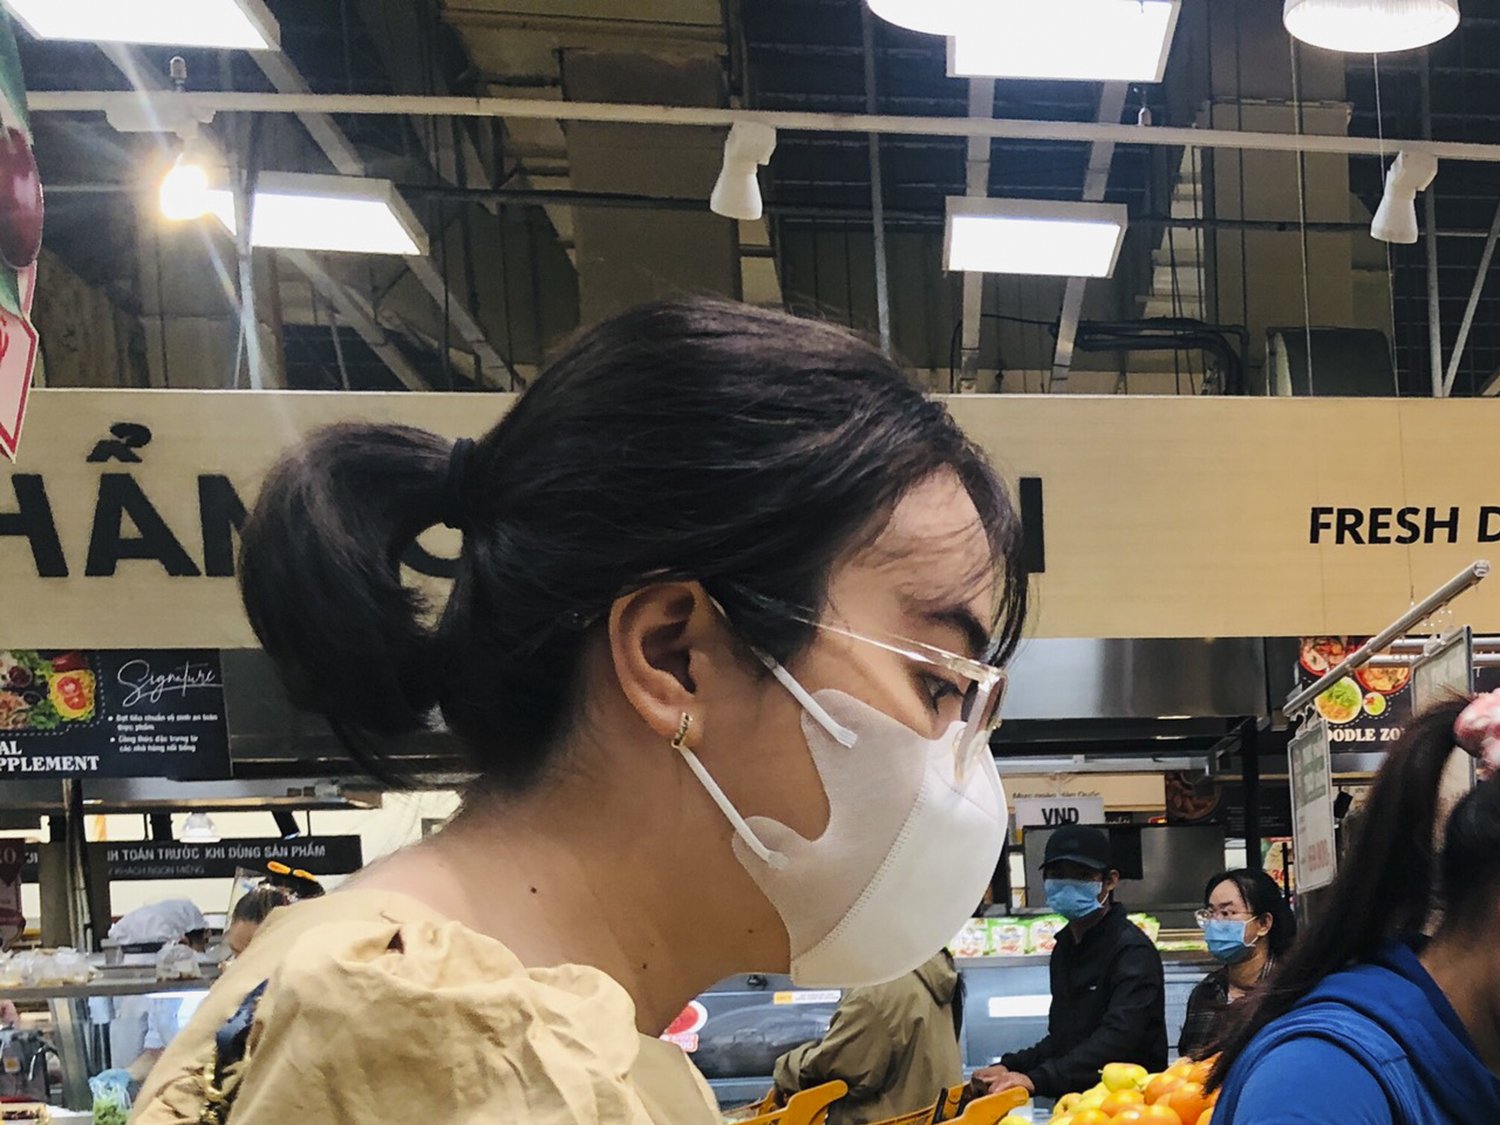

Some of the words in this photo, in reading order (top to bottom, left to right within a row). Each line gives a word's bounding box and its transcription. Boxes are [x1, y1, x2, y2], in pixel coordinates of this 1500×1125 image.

[1309, 506, 1459, 545] FRESH
[117, 659, 222, 708] Signature
[1041, 807, 1079, 825] VND
[122, 847, 154, 861] TOÁN
[159, 845, 199, 860] TRƯỚC
[204, 846, 226, 860] KHI
[228, 844, 261, 858] DÙNG
[264, 842, 289, 858] SẢN
[291, 841, 326, 857] PHẨM
